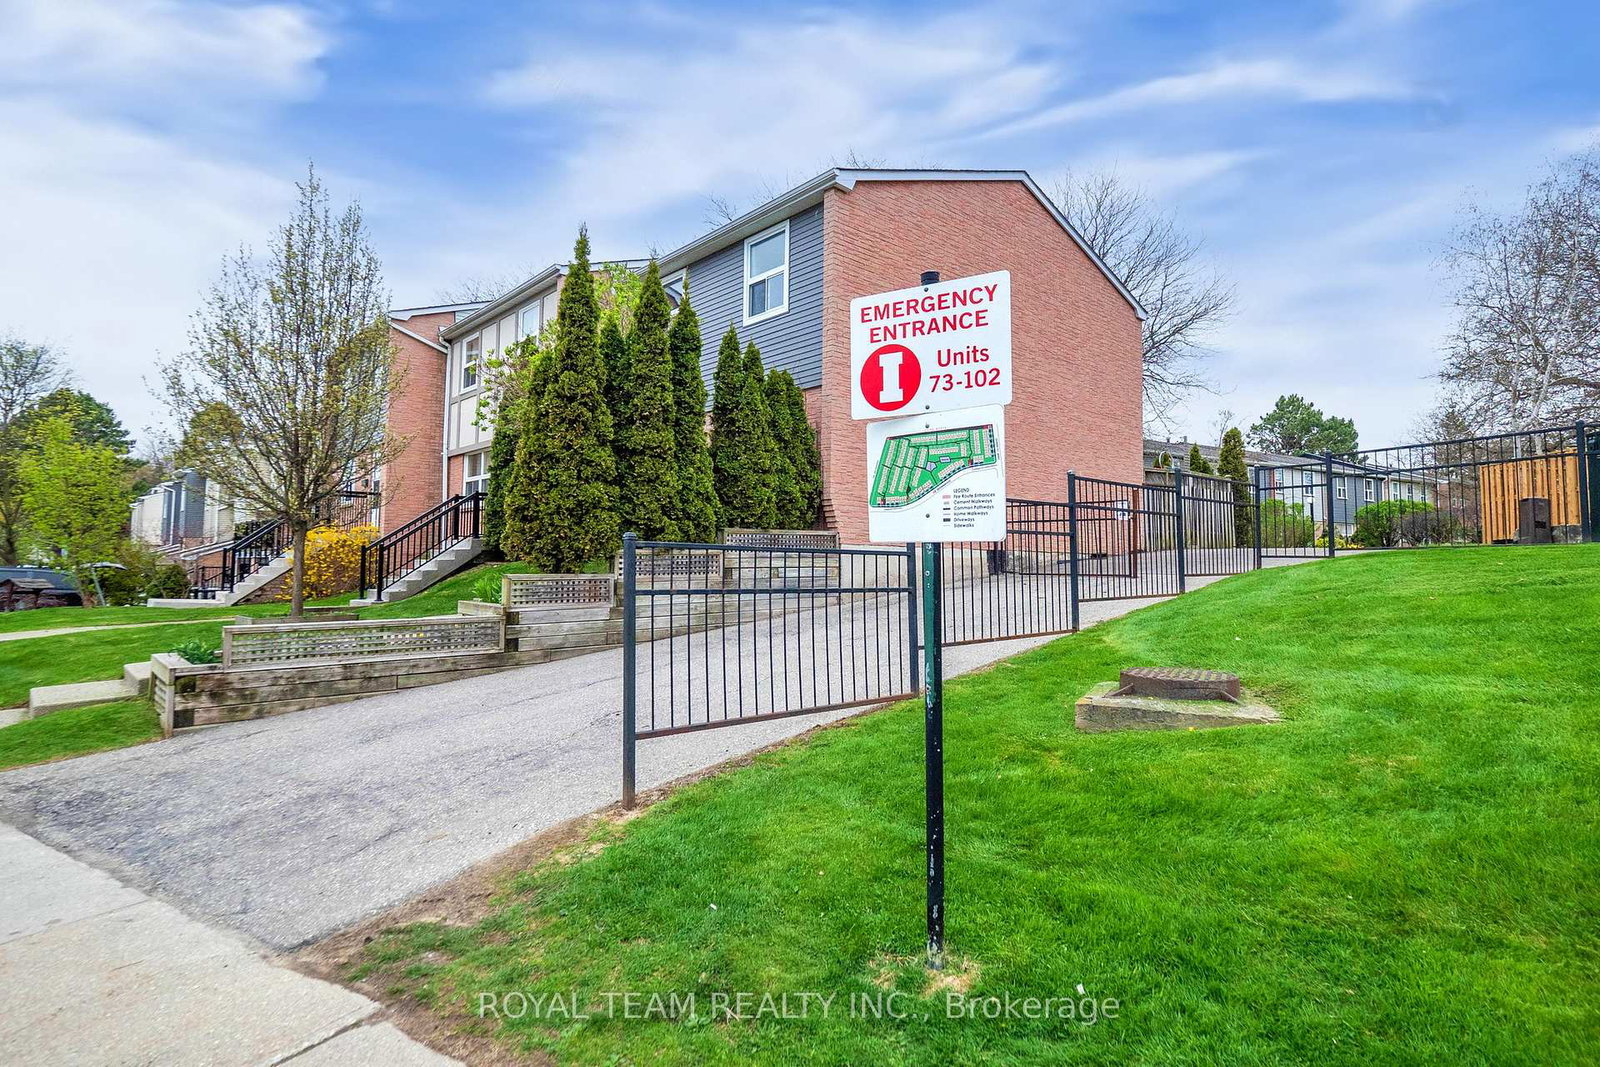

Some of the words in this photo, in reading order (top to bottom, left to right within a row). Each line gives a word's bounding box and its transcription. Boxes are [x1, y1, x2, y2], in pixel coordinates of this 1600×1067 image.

[860, 284, 998, 323] EMERGENCY
[869, 309, 989, 344] ENTRANCE
[937, 345, 990, 367] Units
[878, 351, 904, 404] I
[929, 368, 1001, 393] 73-102
